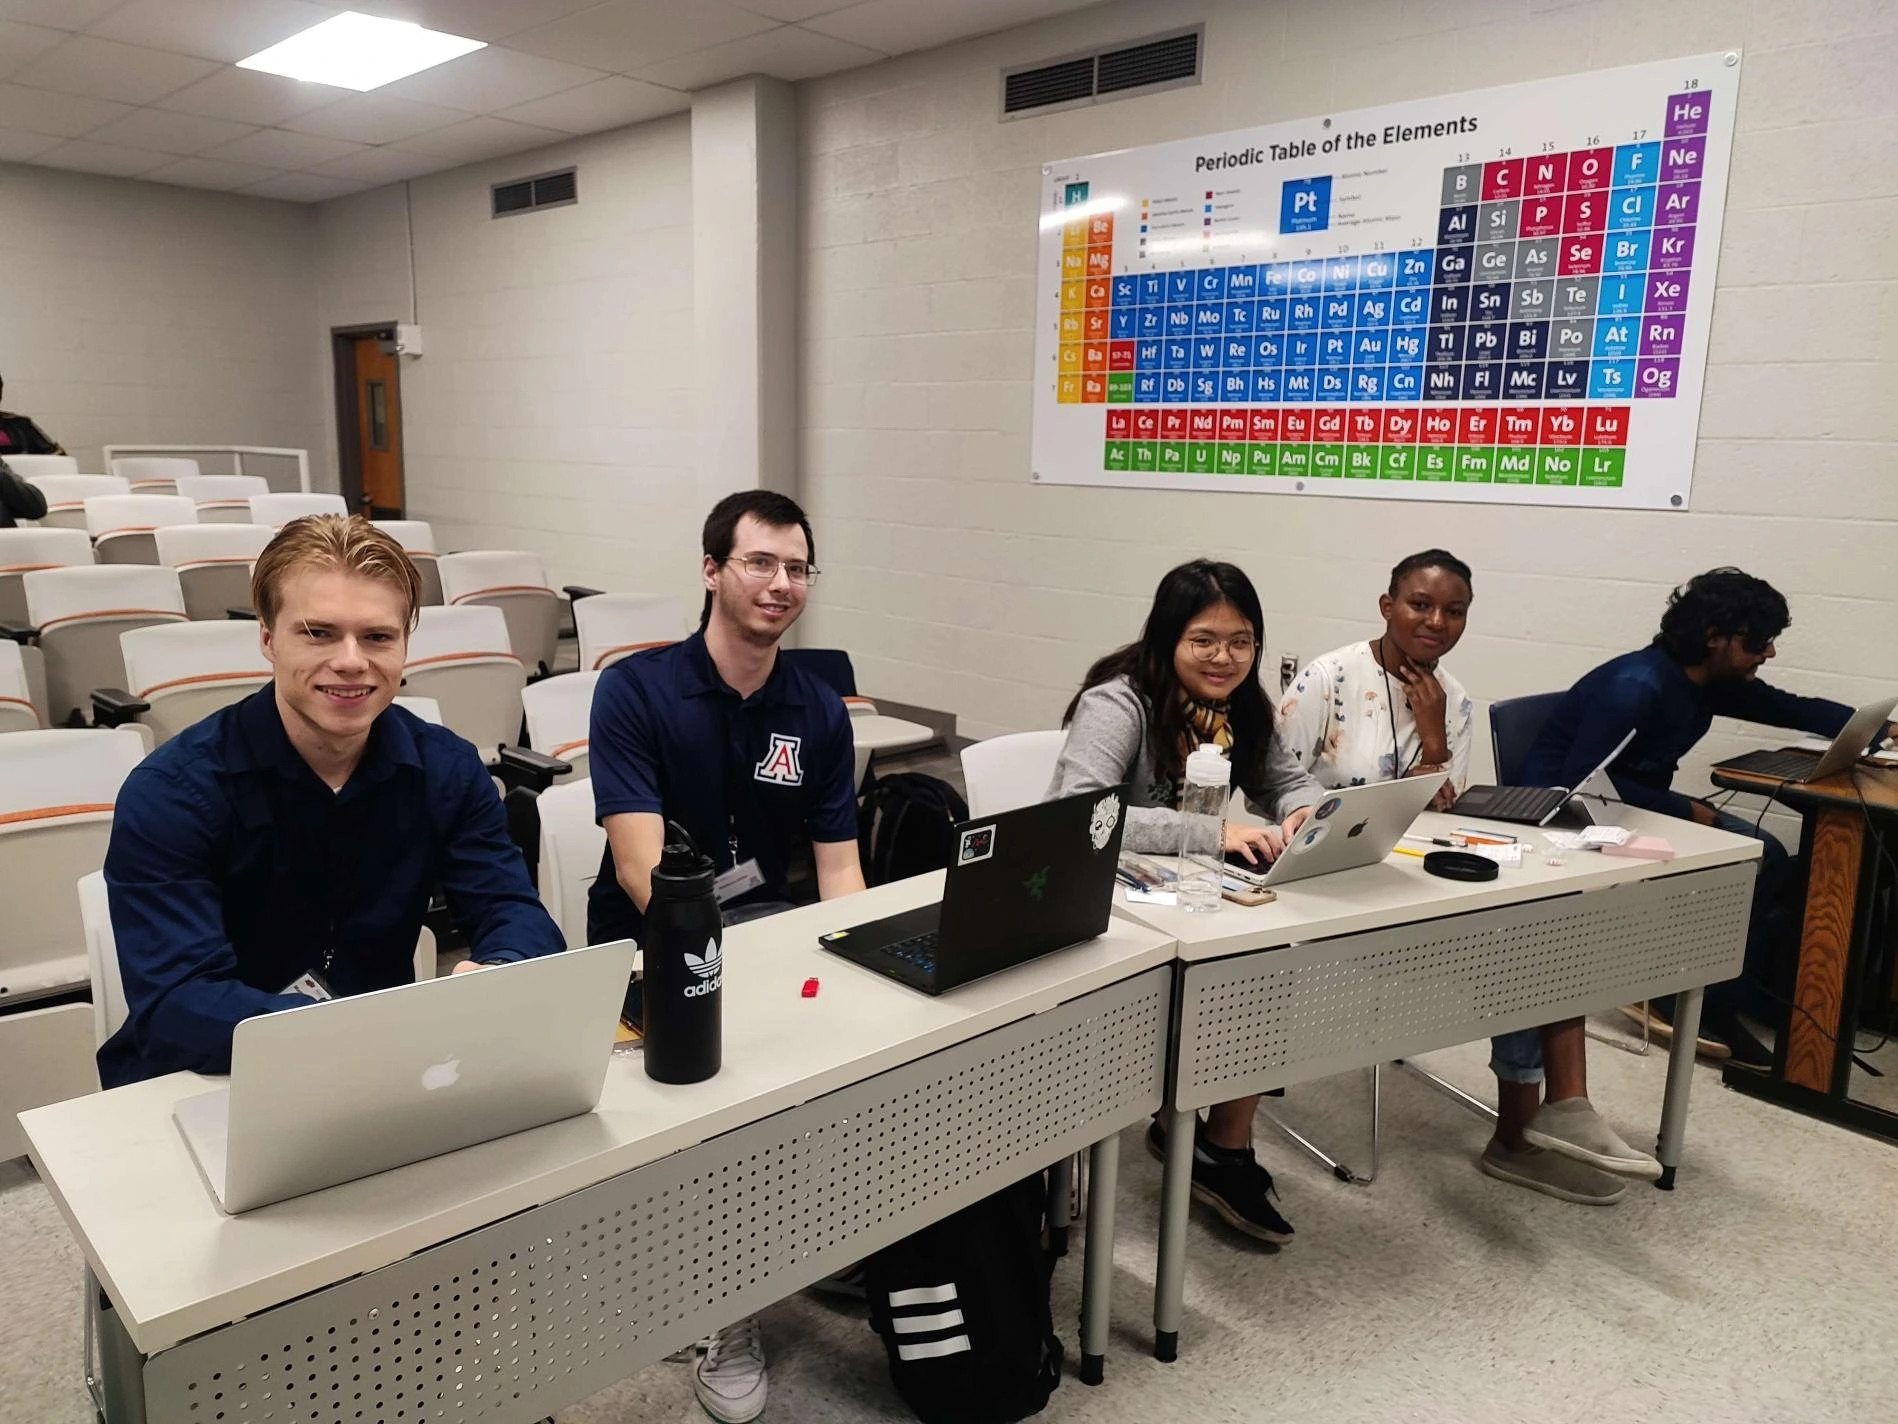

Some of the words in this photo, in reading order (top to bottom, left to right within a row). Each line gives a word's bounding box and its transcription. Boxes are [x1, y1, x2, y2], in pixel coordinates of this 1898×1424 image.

[1684, 79, 1698, 90] 18
[1674, 104, 1702, 121] He
[1587, 136, 1600, 146] 16
[1633, 130, 1646, 140] 17
[1196, 148, 1264, 172] Periodic
[1270, 140, 1317, 162] Table
[1322, 134, 1341, 154] of
[1346, 131, 1376, 150] the
[1383, 116, 1478, 144] Elements
[1542, 142, 1554, 152] 15
[1500, 148, 1512, 157] 14
[1669, 149, 1697, 166] Ne
[1582, 158, 1598, 175] O
[1631, 153, 1642, 170] F
[1496, 169, 1509, 185] C
[1538, 164, 1553, 181] N
[1456, 175, 1467, 190] B
[1072, 190, 1081, 202] H
[1294, 191, 1317, 213] Pt
[1665, 193, 1690, 210] Ar
[1580, 201, 1591, 218] S
[1622, 195, 1641, 214] Cl
[1490, 209, 1507, 227] Si
[1535, 206, 1548, 222] P
[1448, 214, 1466, 231] Al
[1570, 244, 1592, 261] Se
[1617, 241, 1638, 257] Br
[1662, 237, 1685, 254] Kr
[1090, 253, 1109, 269] Mg
[1442, 255, 1465, 271] Ga
[1482, 252, 1506, 268] Ge
[1525, 249, 1547, 264] As
[1333, 264, 1350, 280] Ni
[1367, 262, 1388, 277] Cu
[1404, 259, 1425, 274] Zn
[1204, 276, 1218, 289] Cr
[1230, 274, 1253, 287] Mn
[1266, 271, 1281, 285] Fe
[1298, 268, 1316, 282] Co
[1090, 285, 1105, 298] Ca
[1118, 283, 1131, 295] Sc
[1147, 280, 1158, 293] Ti
[1177, 278, 1186, 291] V
[1654, 281, 1681, 298] Xe
[1442, 295, 1458, 310] In
[1479, 292, 1500, 308] Sn
[1521, 288, 1544, 306] Sb
[1566, 287, 1586, 303] Te
[1295, 304, 1313, 319] Rh
[1329, 301, 1348, 316] Pd
[1363, 300, 1385, 319] Ag
[1401, 296, 1422, 313] Cd
[1144, 314, 1157, 327] Zr
[1170, 312, 1189, 325] Nb
[1198, 310, 1220, 323] Mo
[1233, 308, 1246, 322] Tc
[1262, 307, 1280, 320] Ru
[1091, 317, 1102, 329] Sr
[1119, 316, 1127, 327] Y
[1475, 331, 1497, 348] Pb
[1519, 329, 1537, 346] Bi
[1560, 329, 1583, 344] Po
[1605, 326, 1628, 342] At
[1649, 325, 1675, 341] Rn
[1260, 342, 1278, 355] Os
[1296, 341, 1307, 354] Ir
[1327, 339, 1343, 353] Pt
[1360, 338, 1381, 352] Au
[1396, 336, 1419, 356] Hg
[1439, 333, 1454, 349] Tl
[1142, 346, 1157, 359] Hf
[1171, 345, 1185, 358] Ta
[1200, 344, 1214, 357] W
[1229, 343, 1246, 356] Re
[1258, 377, 1275, 390] Hs
[1288, 376, 1309, 390] Mt
[1324, 375, 1342, 389] Ds
[1394, 373, 1414, 388] Cn
[1430, 372, 1454, 388] Nh
[1475, 371, 1490, 387] Fl
[1510, 371, 1537, 386] Mc
[1557, 370, 1577, 385] Lv
[1603, 368, 1621, 384] Ts
[1643, 367, 1672, 389] Og
[1141, 378, 1154, 391] Rf
[1167, 378, 1185, 391] Db
[1198, 378, 1213, 396] Sg
[1227, 377, 1244, 391] Bh
[1358, 374, 1378, 394] Rg
[1112, 416, 1125, 429] La
[1138, 416, 1153, 429] Ce
[1167, 416, 1181, 429] Pr
[1194, 415, 1213, 429] Nd
[1222, 416, 1244, 429] Pm
[1253, 416, 1275, 430] Sm
[1287, 416, 1305, 430] Eu
[1319, 415, 1340, 430] Gd
[1355, 415, 1374, 431] Tb
[1389, 416, 1412, 436] Dy
[1427, 416, 1450, 431] Ho
[1469, 416, 1487, 431] Er
[1506, 416, 1532, 432] Tm
[1550, 415, 1574, 432] Yb
[1596, 416, 1617, 432] Lu
[1110, 448, 1124, 460] Ac
[1137, 448, 1152, 460] Th
[1165, 448, 1179, 461] Pa
[1196, 450, 1206, 462] U
[1222, 450, 1241, 467] Np
[1253, 450, 1270, 464] Pu
[1282, 451, 1306, 464] Am
[1315, 451, 1339, 465] Cm
[1352, 452, 1371, 467] Bk
[1389, 452, 1407, 468] Cf
[1427, 454, 1443, 469] Es
[1462, 455, 1487, 469] Fm
[1500, 455, 1530, 471] Md
[1545, 456, 1571, 472] No
[1594, 457, 1612, 473] Lr
[754, 733, 804, 786] A
[684, 976, 722, 998] adida
